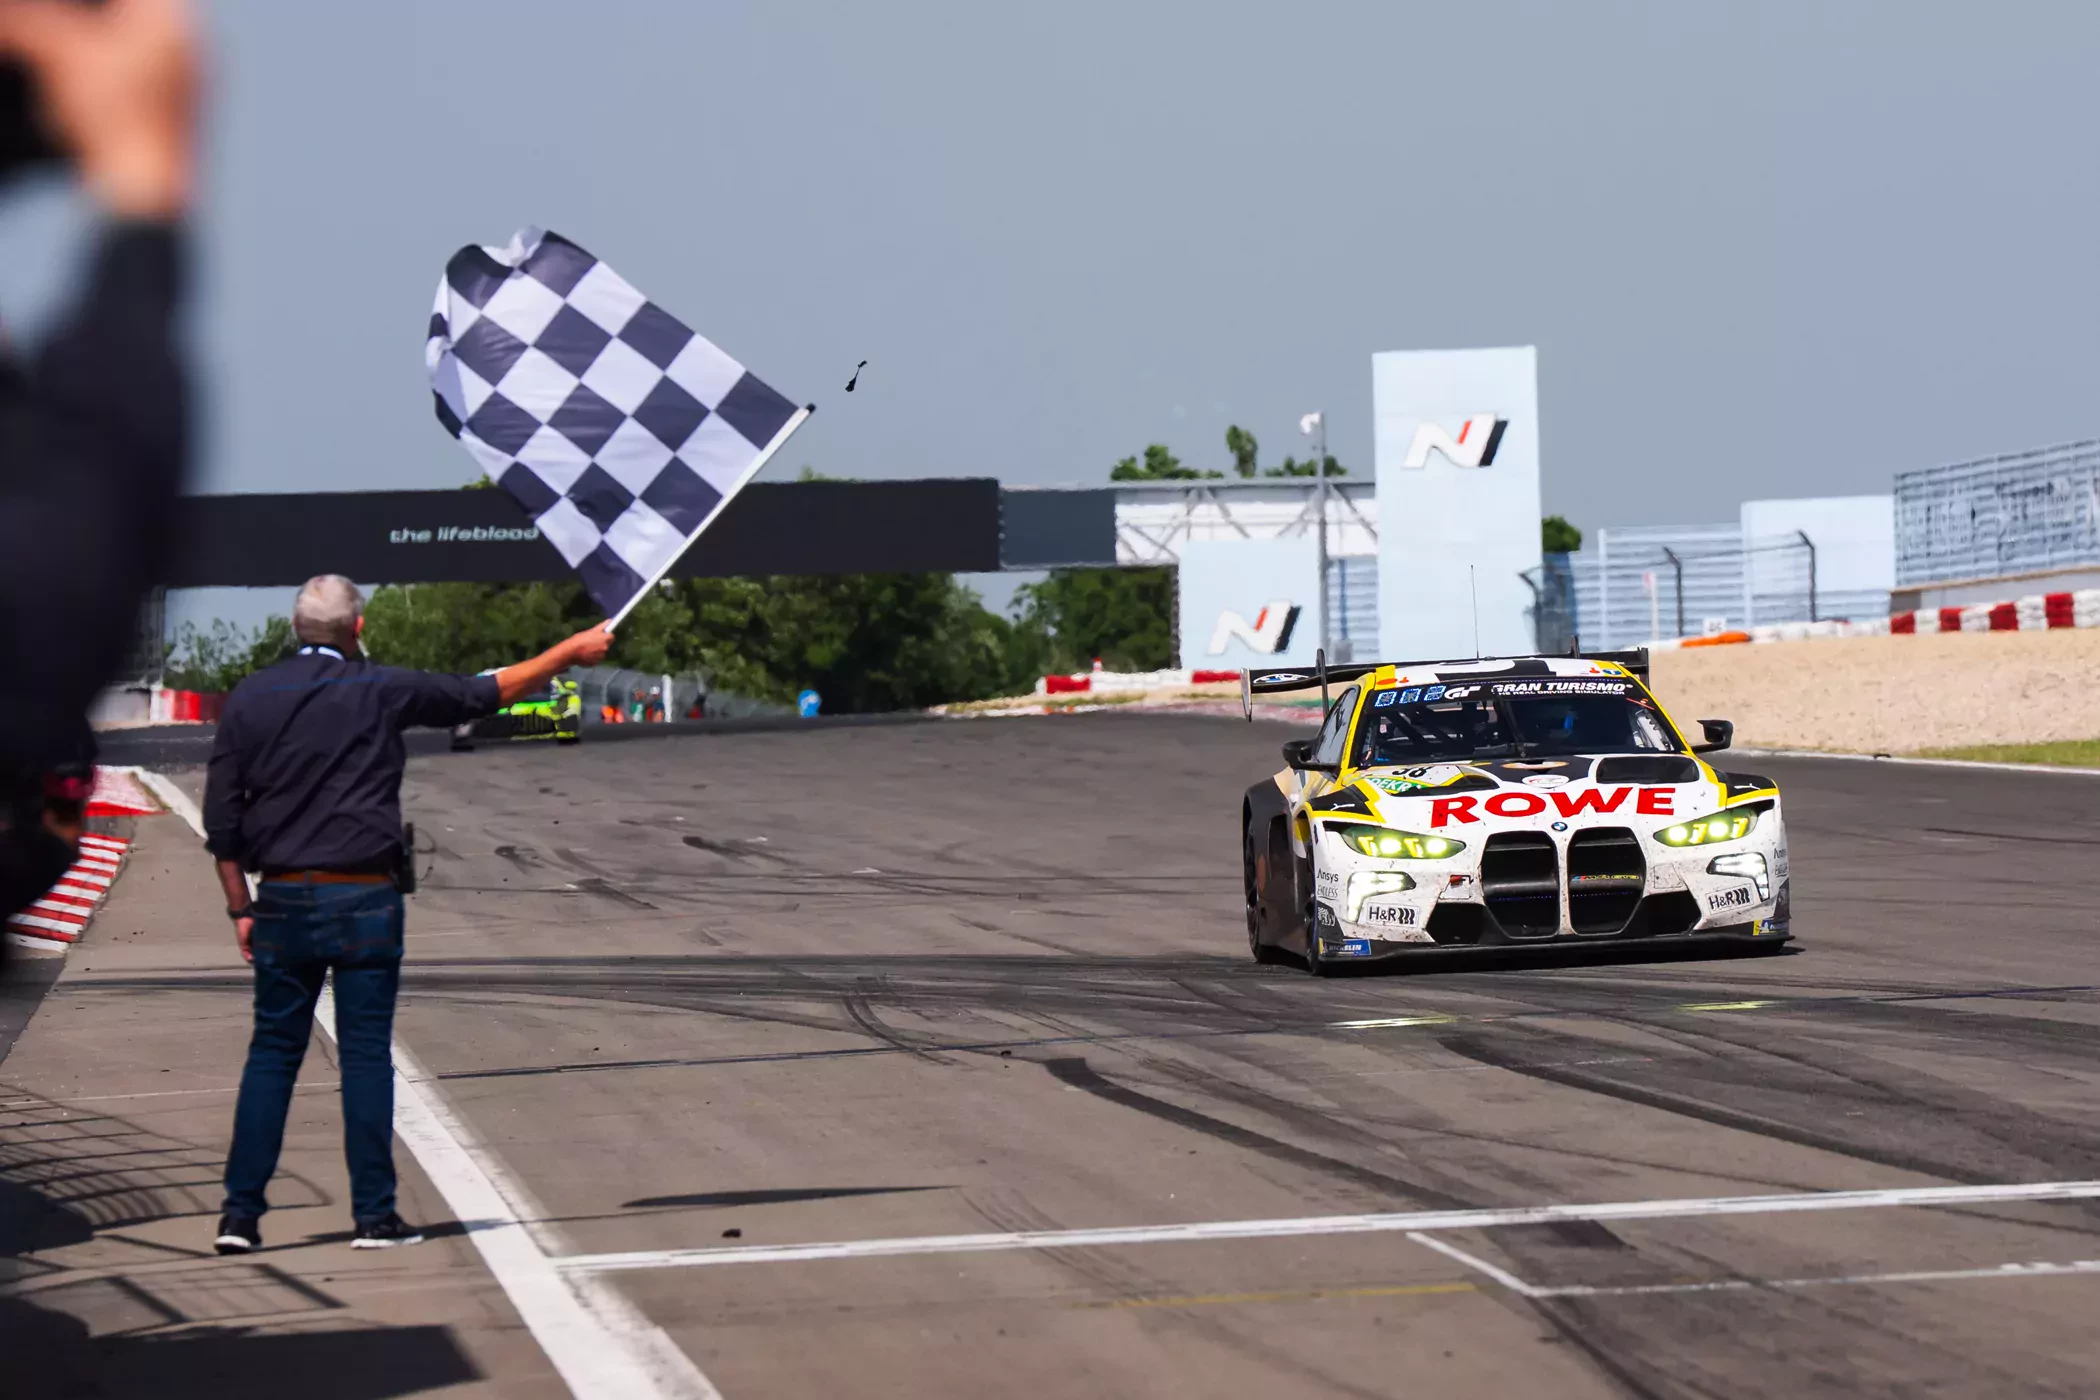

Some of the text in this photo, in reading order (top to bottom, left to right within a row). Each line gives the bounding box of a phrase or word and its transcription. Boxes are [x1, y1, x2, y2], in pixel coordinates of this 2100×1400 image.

[390, 525, 541, 543] the lifeblood
[1491, 682, 1626, 694] GRAN TURISMO
[1428, 786, 1676, 828] ROWE
[1317, 868, 1339, 883] Ansys
[1708, 891, 1735, 910] H&R
[1369, 907, 1396, 921] H&R
